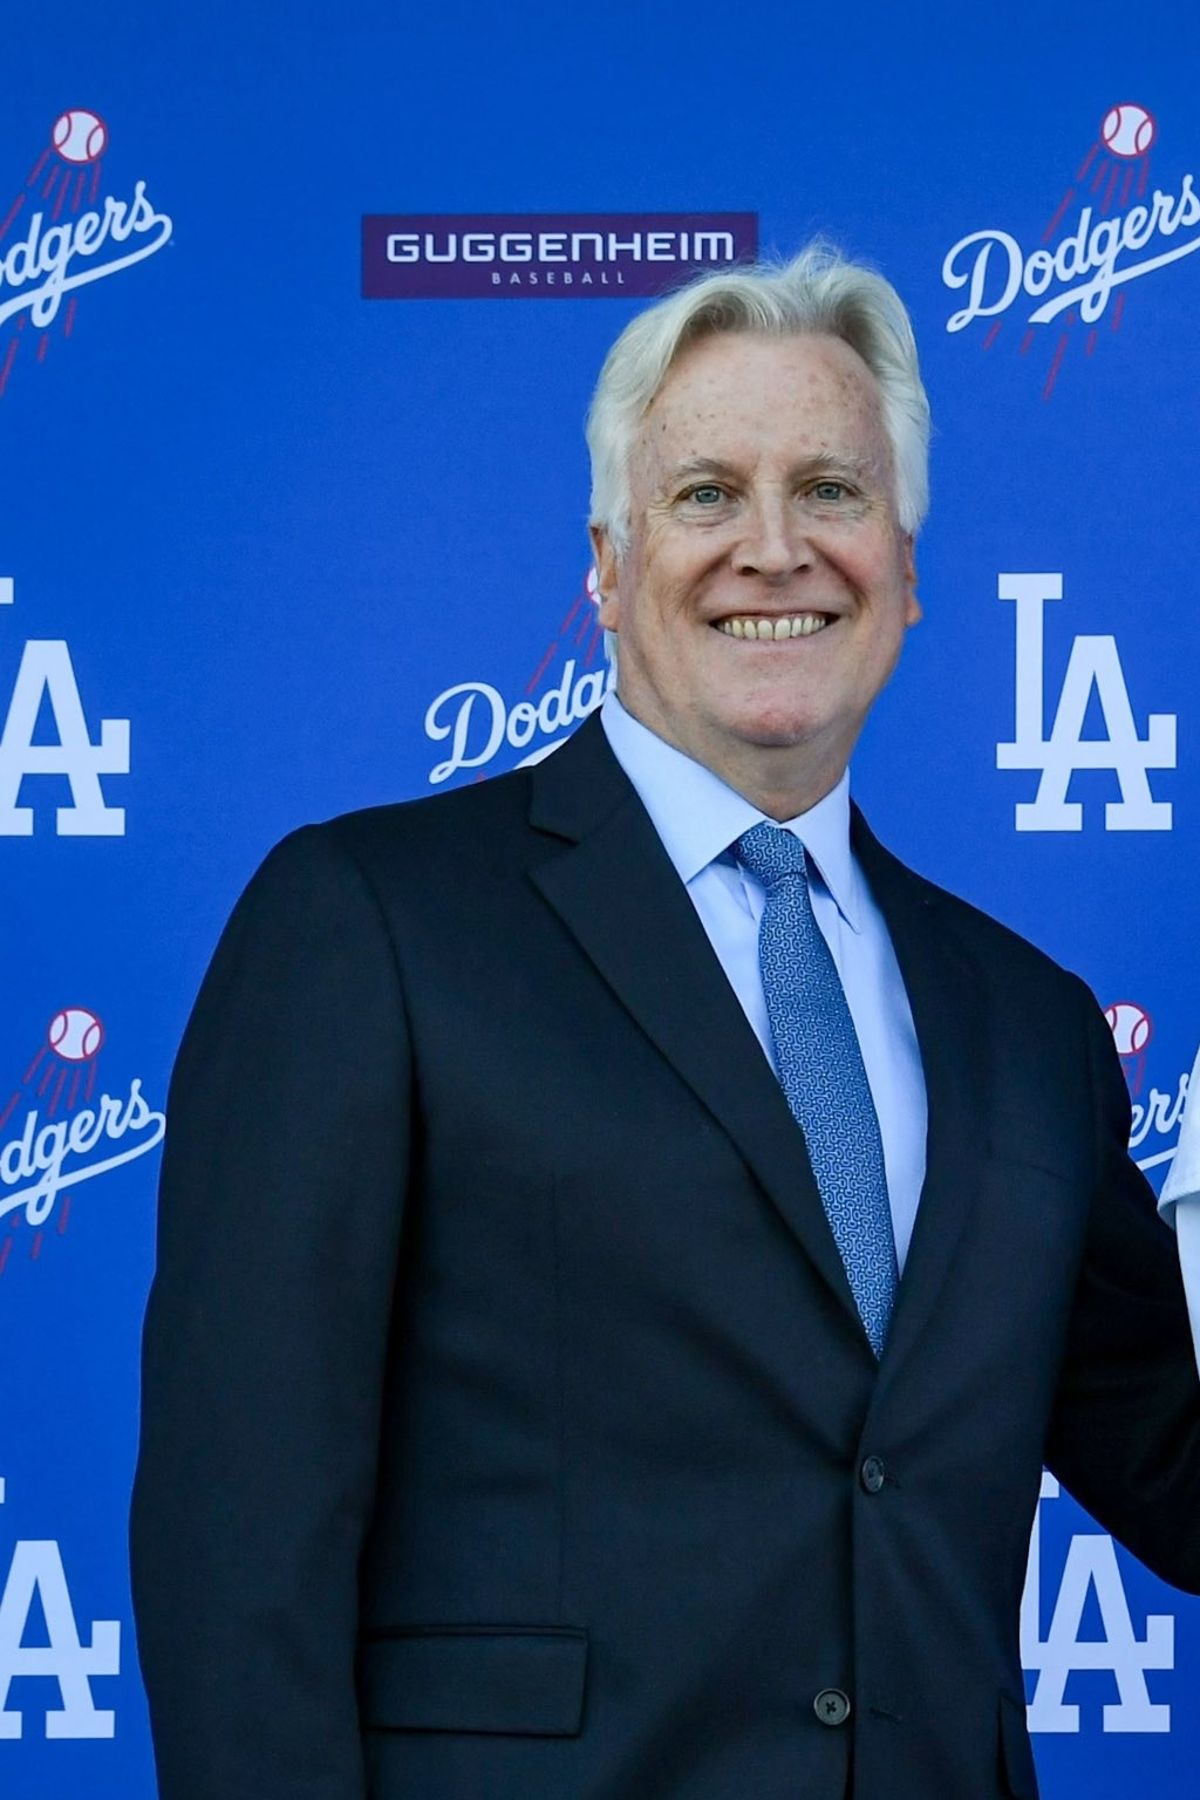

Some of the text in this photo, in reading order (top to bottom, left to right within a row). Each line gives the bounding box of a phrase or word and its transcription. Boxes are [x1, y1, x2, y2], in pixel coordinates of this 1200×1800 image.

[0, 180, 173, 328] dgers
[386, 232, 734, 263] GUGGENHEIM
[491, 271, 626, 286] BASEBALL
[0, 576, 130, 836] A
[425, 659, 606, 785] Dodg
[997, 573, 1177, 831] LA
[0, 1078, 166, 1226] dgers
[0, 1476, 120, 1739] A
